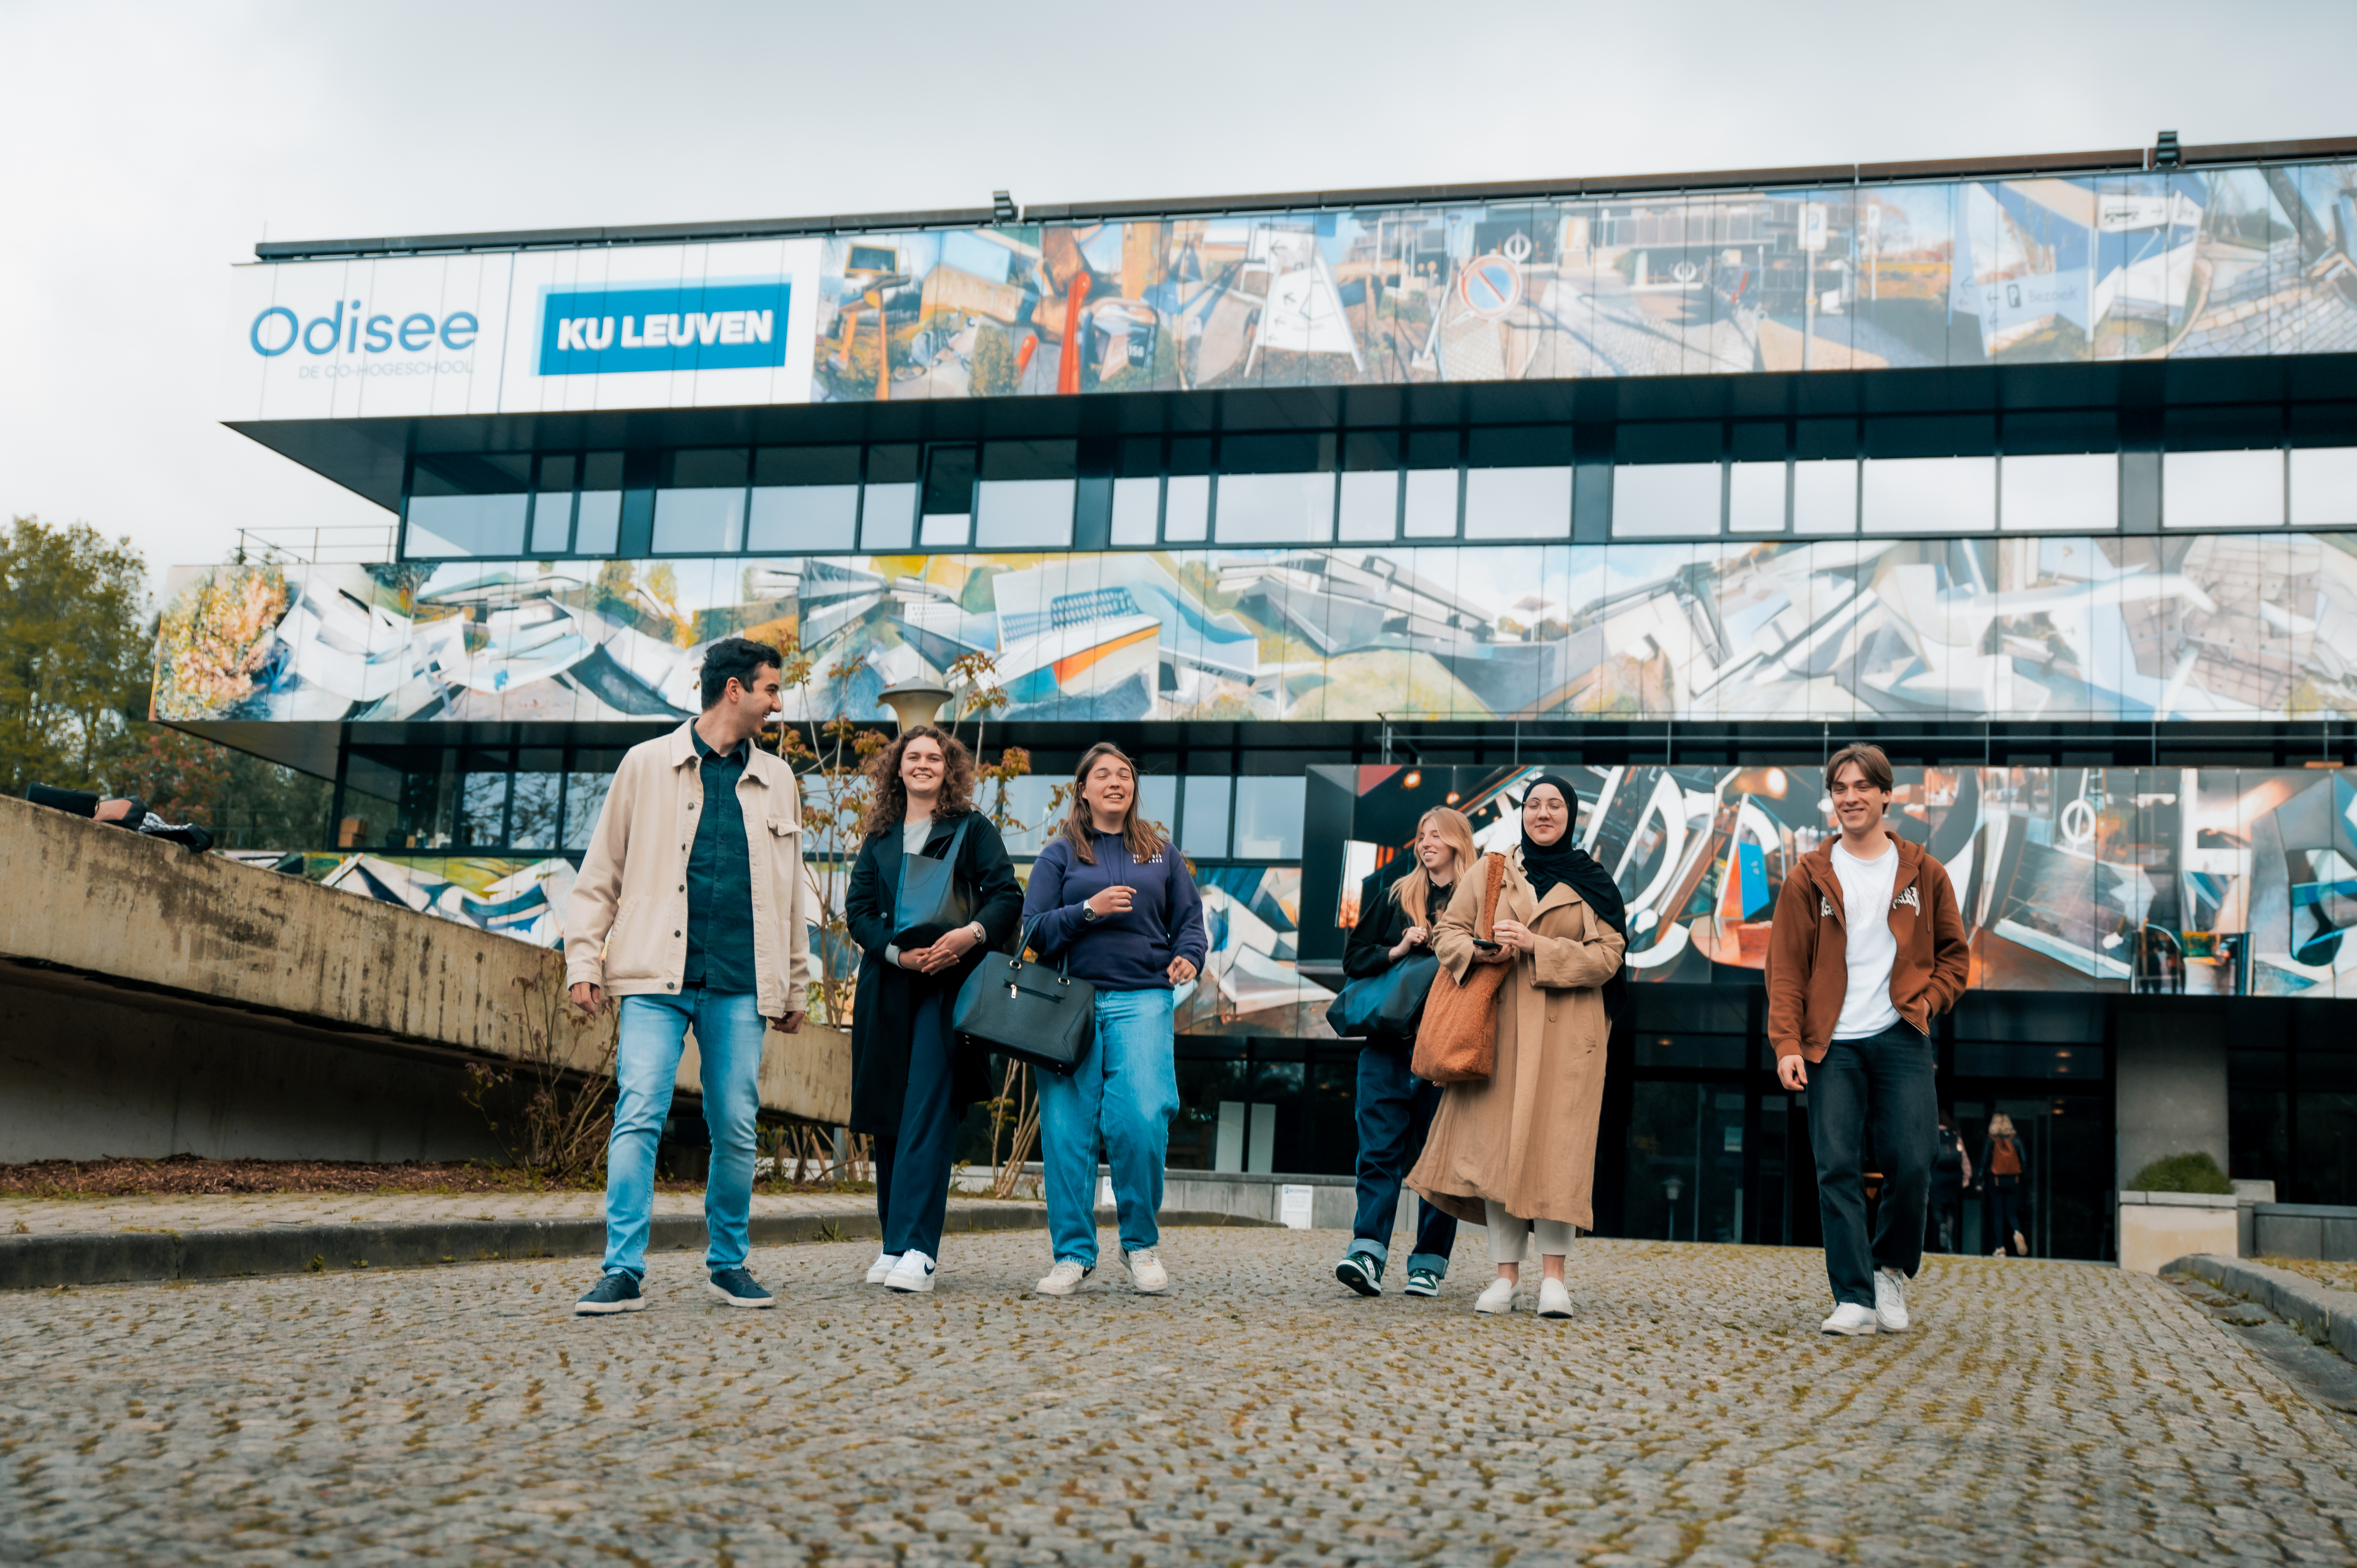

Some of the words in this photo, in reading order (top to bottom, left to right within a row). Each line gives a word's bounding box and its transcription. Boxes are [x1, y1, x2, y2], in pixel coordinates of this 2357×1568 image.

[250, 299, 479, 356] Odisee
[557, 316, 615, 351] KU
[621, 309, 773, 348] LEUVEN
[298, 365, 320, 379] DE
[324, 360, 474, 378] CO-HOGESCHOOL
